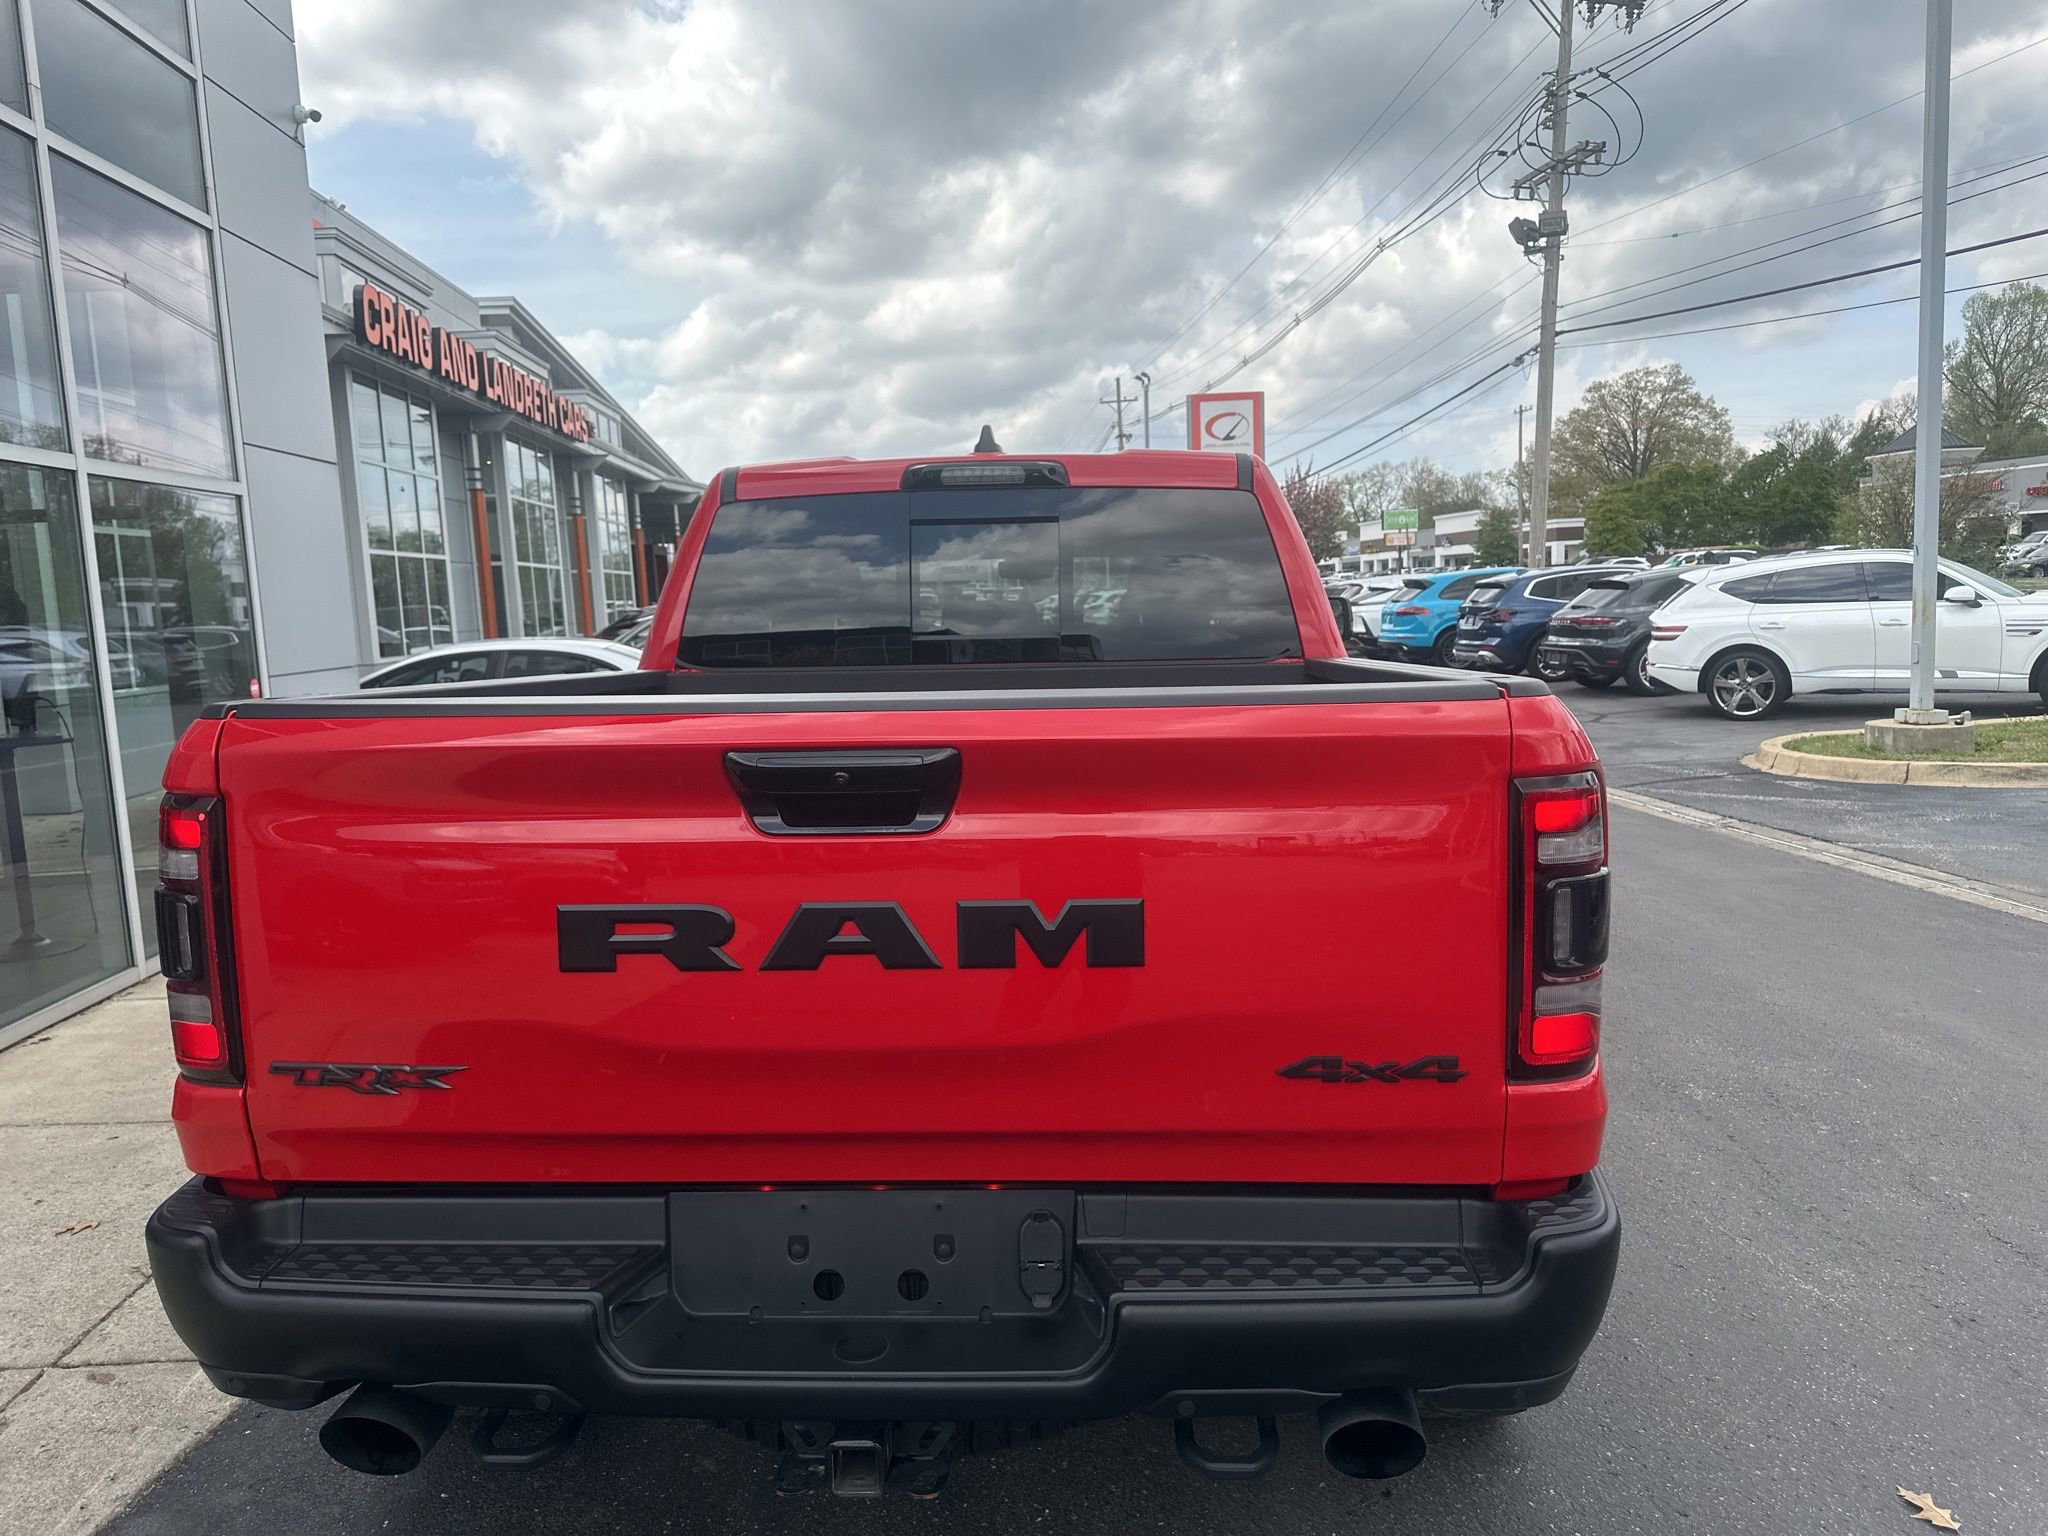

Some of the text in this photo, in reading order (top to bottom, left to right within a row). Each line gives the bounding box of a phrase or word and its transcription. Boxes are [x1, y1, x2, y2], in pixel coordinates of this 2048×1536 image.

[363, 284, 588, 443] CRAIG AND LANDRETH CARS
[558, 898, 1145, 972] RAM
[269, 1060, 470, 1095] TRX
[1275, 1055, 1468, 1083] 4x4
